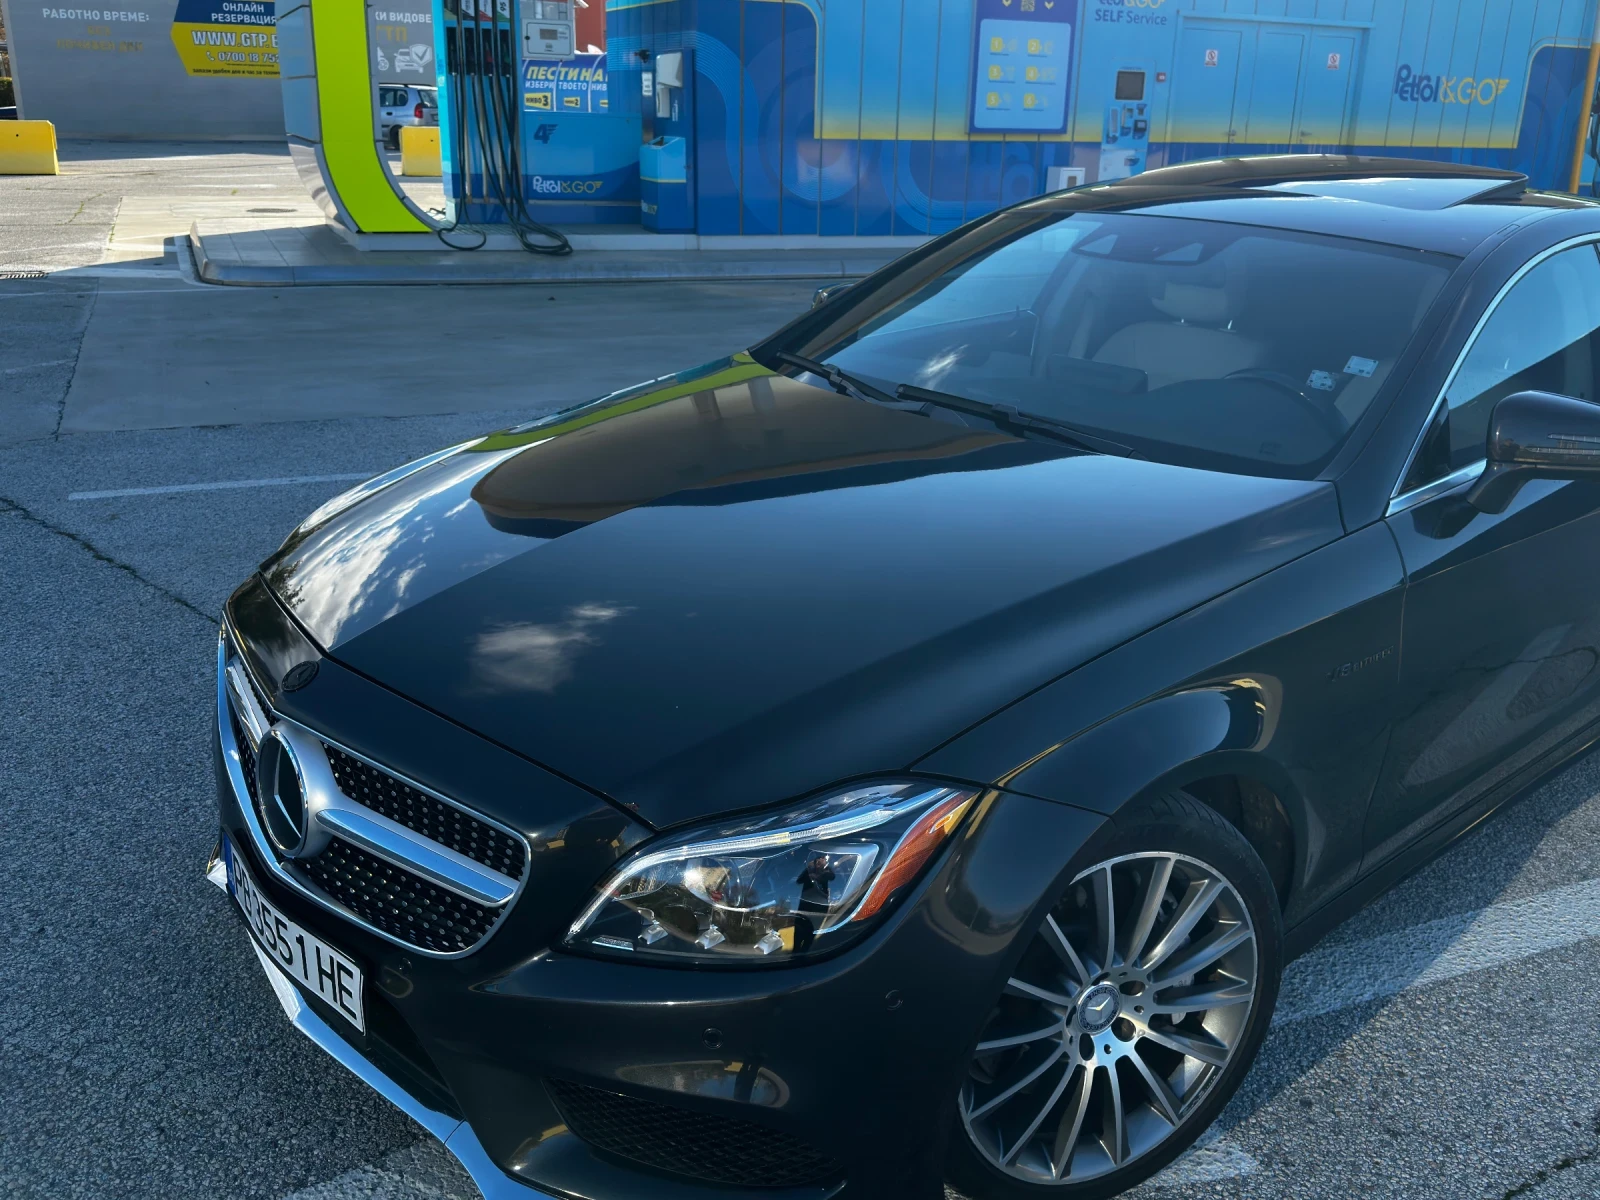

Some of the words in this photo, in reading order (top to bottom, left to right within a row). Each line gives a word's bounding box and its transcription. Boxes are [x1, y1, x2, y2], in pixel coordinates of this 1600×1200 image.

[222, 2, 265, 13] ОНЛАЙН
[42, 8, 100, 21] РАБОТНО
[103, 11, 150, 22] ВРЕМЕ:
[211, 13, 277, 25] РЕЗЕРВАЦИЯ
[389, 12, 432, 24] ВИДОВЕ
[1095, 9, 1124, 22] SELF
[1126, 11, 1167, 25] Service
[219, 52, 245, 62] 0700
[248, 54, 259, 62] 18
[525, 80, 555, 89] ИЗБЕРИ
[558, 82, 588, 90] ТВОЕТО
[542, 95, 549, 106] 3
